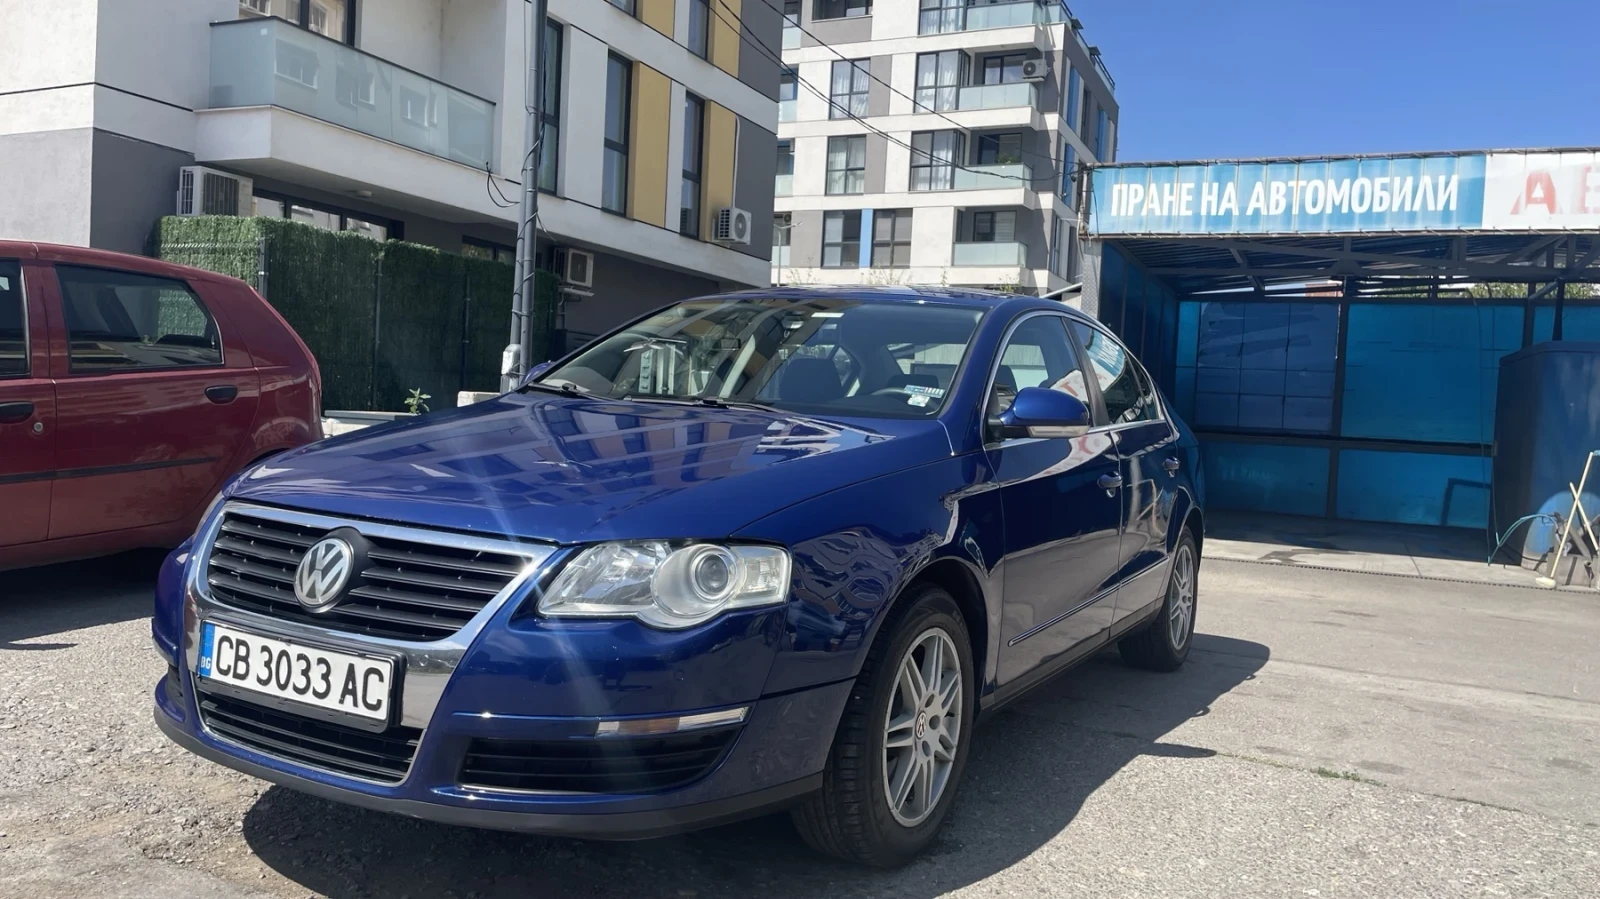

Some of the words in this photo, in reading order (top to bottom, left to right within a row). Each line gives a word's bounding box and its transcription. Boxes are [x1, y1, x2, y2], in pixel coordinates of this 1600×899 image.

[1111, 182, 1195, 217] ПРАНЕ
[1200, 181, 1240, 216] НА
[1246, 174, 1459, 216] АВТОМОБИЛИ
[201, 655, 211, 670] BG
[216, 635, 250, 681] CB
[256, 645, 331, 700] 3033
[338, 663, 384, 712] AC
